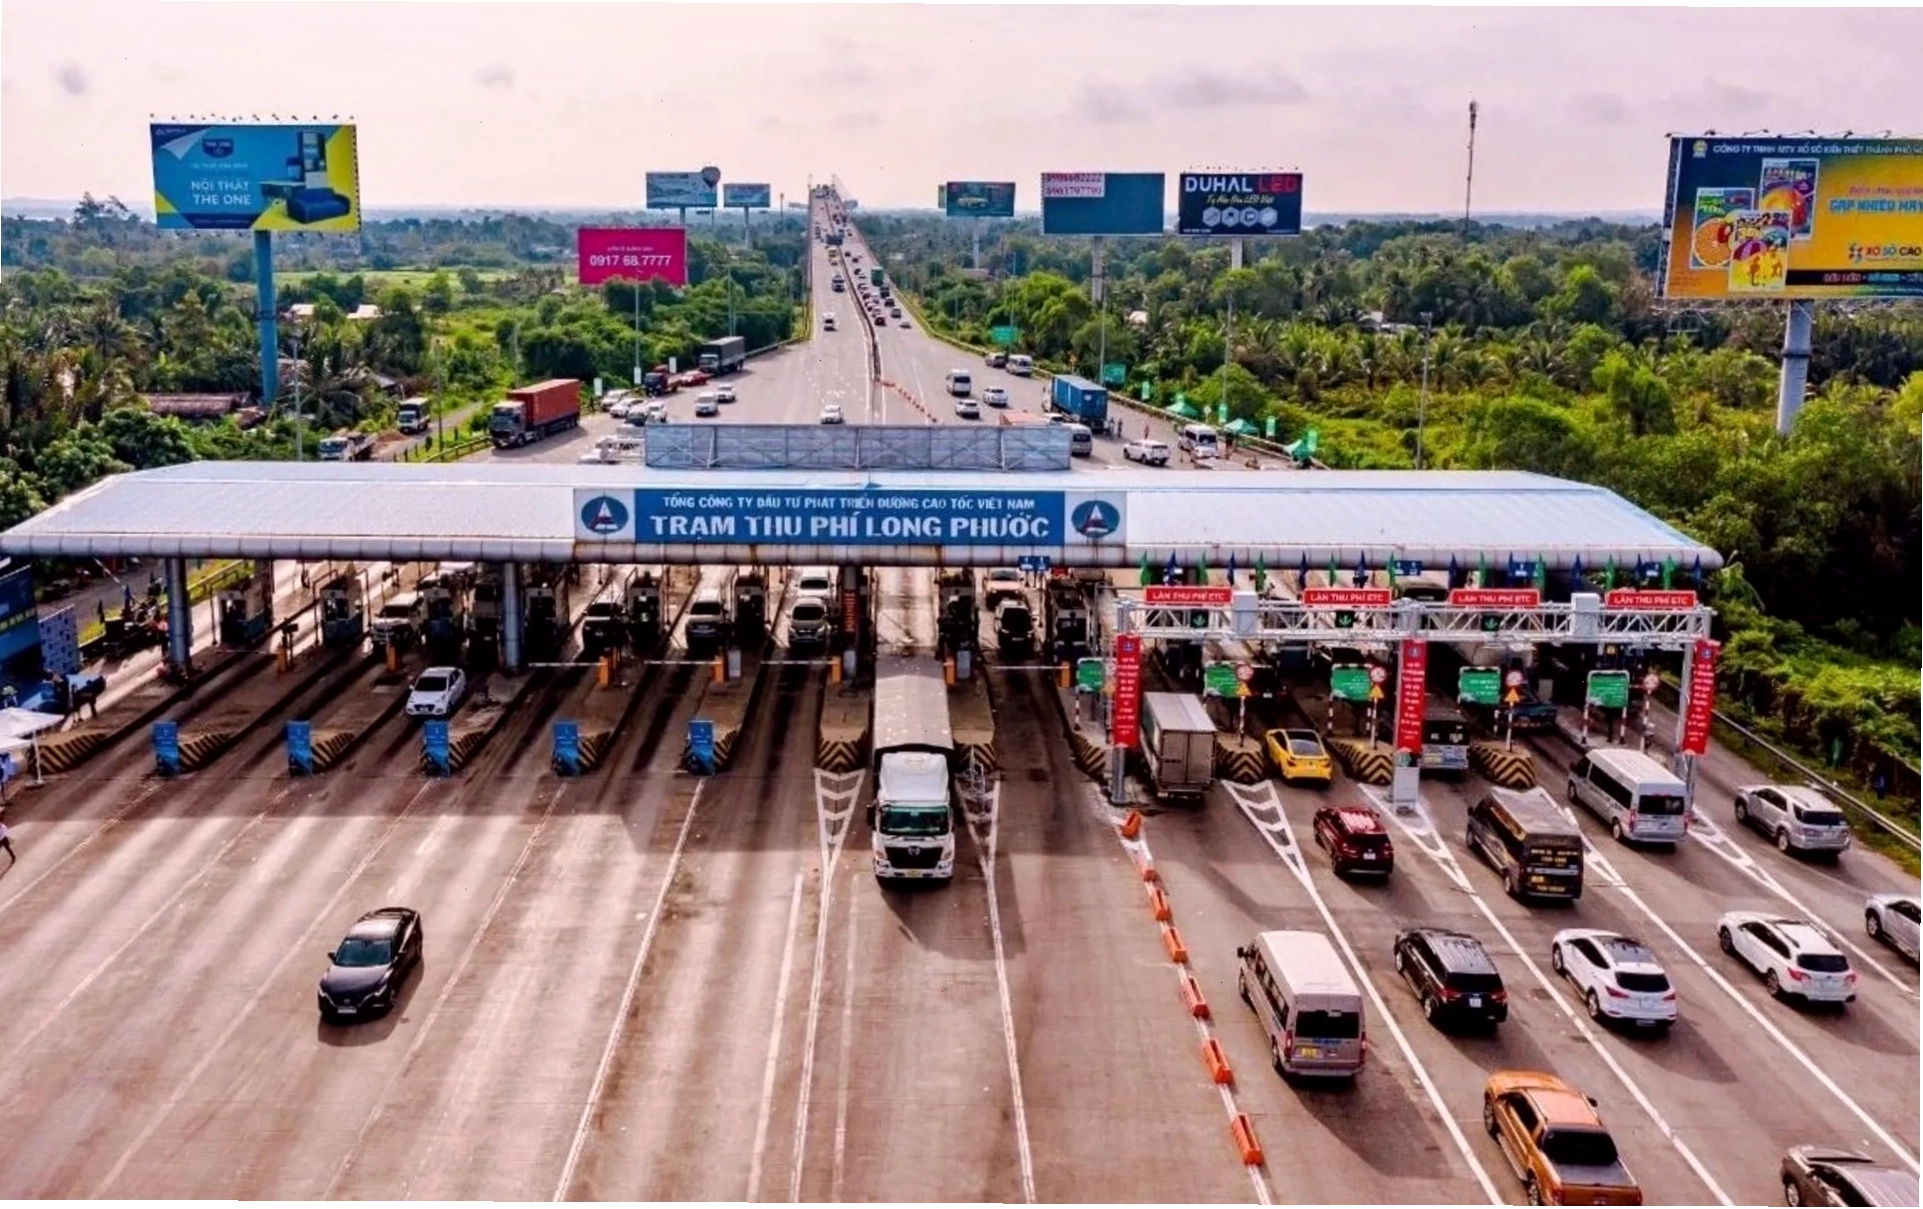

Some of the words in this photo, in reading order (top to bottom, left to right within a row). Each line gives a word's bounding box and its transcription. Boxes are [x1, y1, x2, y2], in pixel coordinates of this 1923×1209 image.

[191, 178, 214, 194] NỘI
[218, 177, 249, 191] THẤT
[1185, 177, 1253, 192] DUHAL
[1259, 176, 1297, 192] LED
[194, 195, 218, 205] THE
[223, 194, 252, 205] ONE
[589, 254, 619, 266] 0917
[663, 492, 695, 508] TỔNG
[699, 494, 733, 508] CÔNG
[738, 497, 753, 508] TY
[785, 496, 801, 508] TƯ
[804, 494, 836, 508] PHÁT
[840, 493, 874, 509] TRIỂN
[922, 498, 947, 509] CAO
[951, 494, 974, 509] TỐC
[978, 495, 1002, 510] VIỆT
[1007, 498, 1035, 509] NAM
[650, 515, 735, 540] TRẠM
[744, 515, 802, 537] THU
[810, 511, 861, 537] PHÍ
[866, 516, 942, 538] LONG
[950, 511, 1049, 538] PHƯỚC
[1172, 592, 1190, 600] THU
[1209, 592, 1225, 600] ETC
[1330, 593, 1348, 601] THU
[1367, 593, 1384, 602] ETC
[1479, 595, 1496, 603] THU
[1515, 595, 1531, 603] ETC
[1634, 596, 1652, 604] THU
[1671, 596, 1687, 604] ETC
